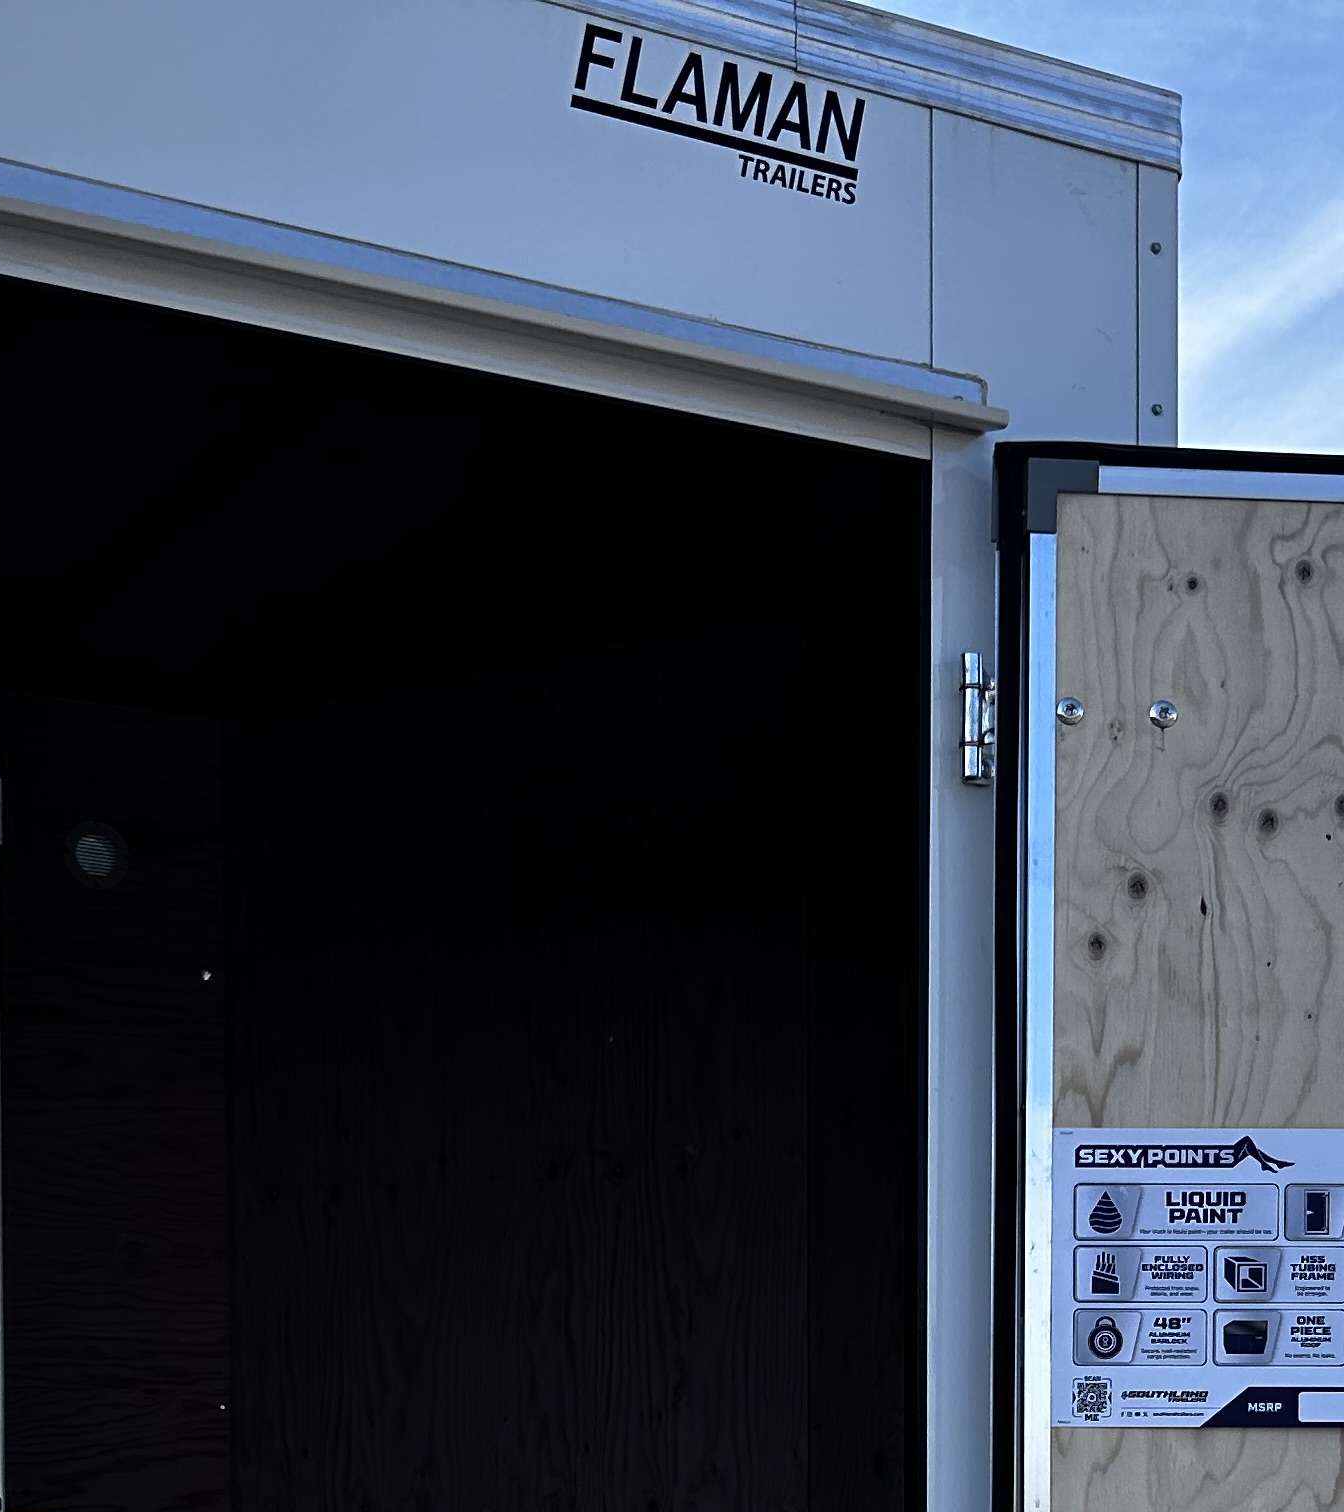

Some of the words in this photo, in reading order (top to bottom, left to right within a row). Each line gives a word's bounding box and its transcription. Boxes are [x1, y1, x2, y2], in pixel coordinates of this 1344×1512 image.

[575, 23, 866, 162] FLAMAN
[738, 154, 858, 205] TRAILERS
[1078, 1148, 1145, 1164] SEXY
[1147, 1148, 1235, 1165] POINTS
[1165, 1191, 1247, 1208] LIQUID
[1168, 1208, 1243, 1224] PAINT
[1154, 1255, 1190, 1263] FULLY
[1300, 1255, 1326, 1264] HSS
[1141, 1263, 1204, 1272] ENCLOSED
[1289, 1263, 1336, 1272] TUBING
[1151, 1271, 1194, 1280] WIRING
[1291, 1272, 1335, 1281] FRAME
[1153, 1317, 1192, 1329] 48"
[1296, 1315, 1326, 1325] ONE
[1290, 1326, 1332, 1336] PIECE
[1126, 1390, 1209, 1399] SOUTHLAND
[1247, 1402, 1283, 1413] MSRP
[1084, 1413, 1100, 1422] ME
